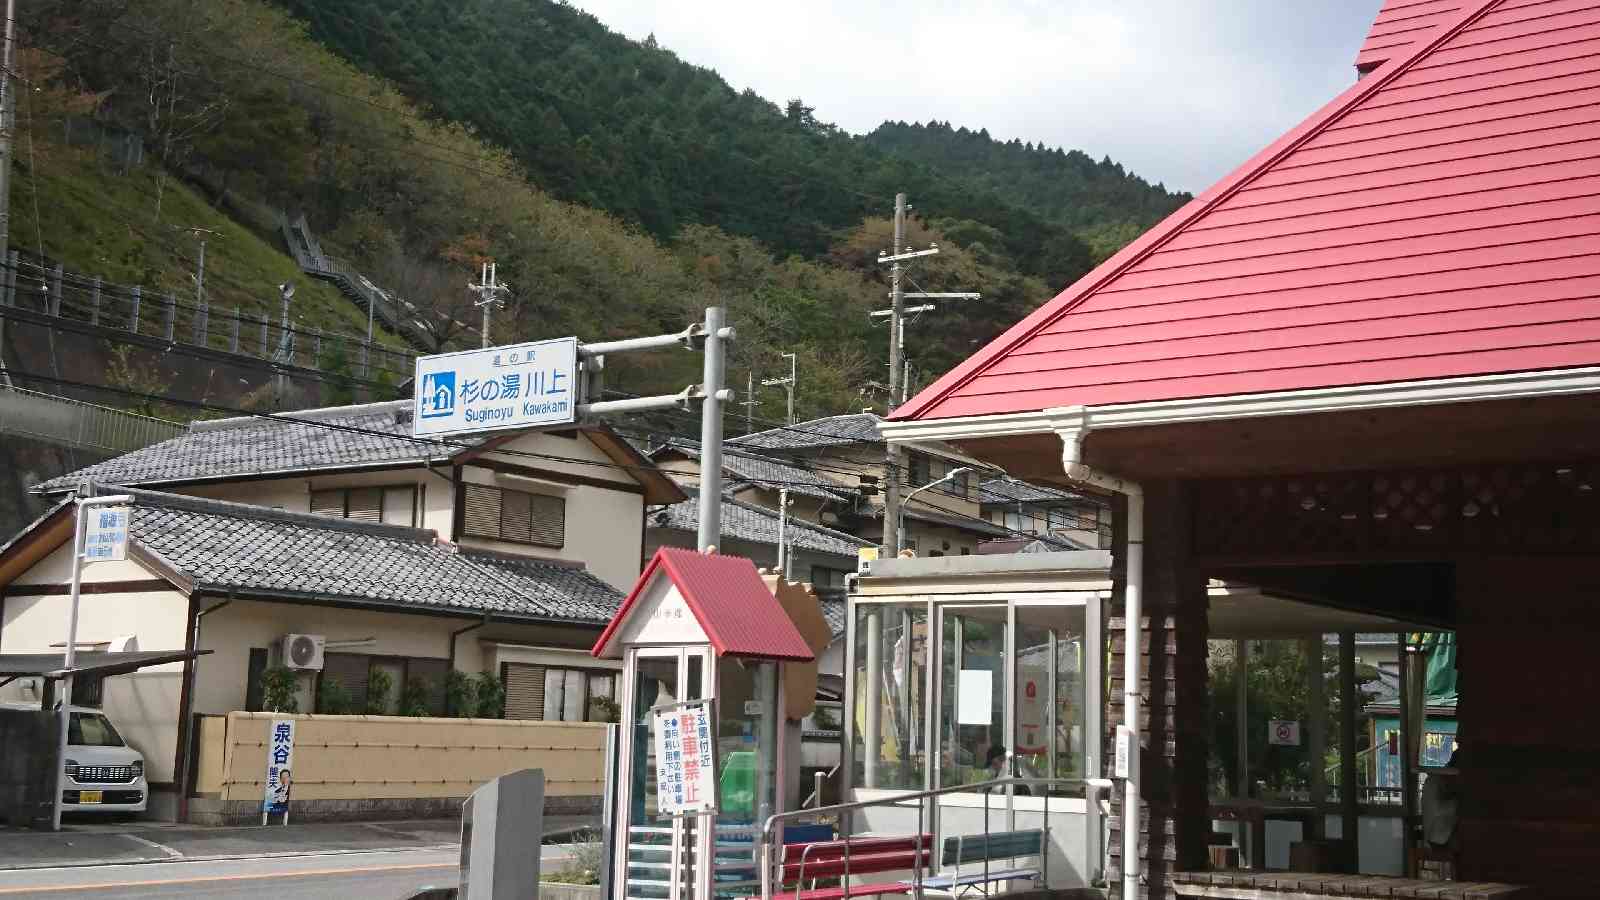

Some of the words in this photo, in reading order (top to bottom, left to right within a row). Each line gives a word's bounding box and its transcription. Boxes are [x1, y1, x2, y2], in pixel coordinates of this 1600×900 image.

[460, 373, 520, 404] 杉の湯
[525, 368, 567, 397] 川上
[465, 406, 514, 422] Suginoyu
[523, 398, 568, 416] Kawakami
[274, 722, 291, 765] 泉谷
[680, 714, 701, 803] 駐車禁止
